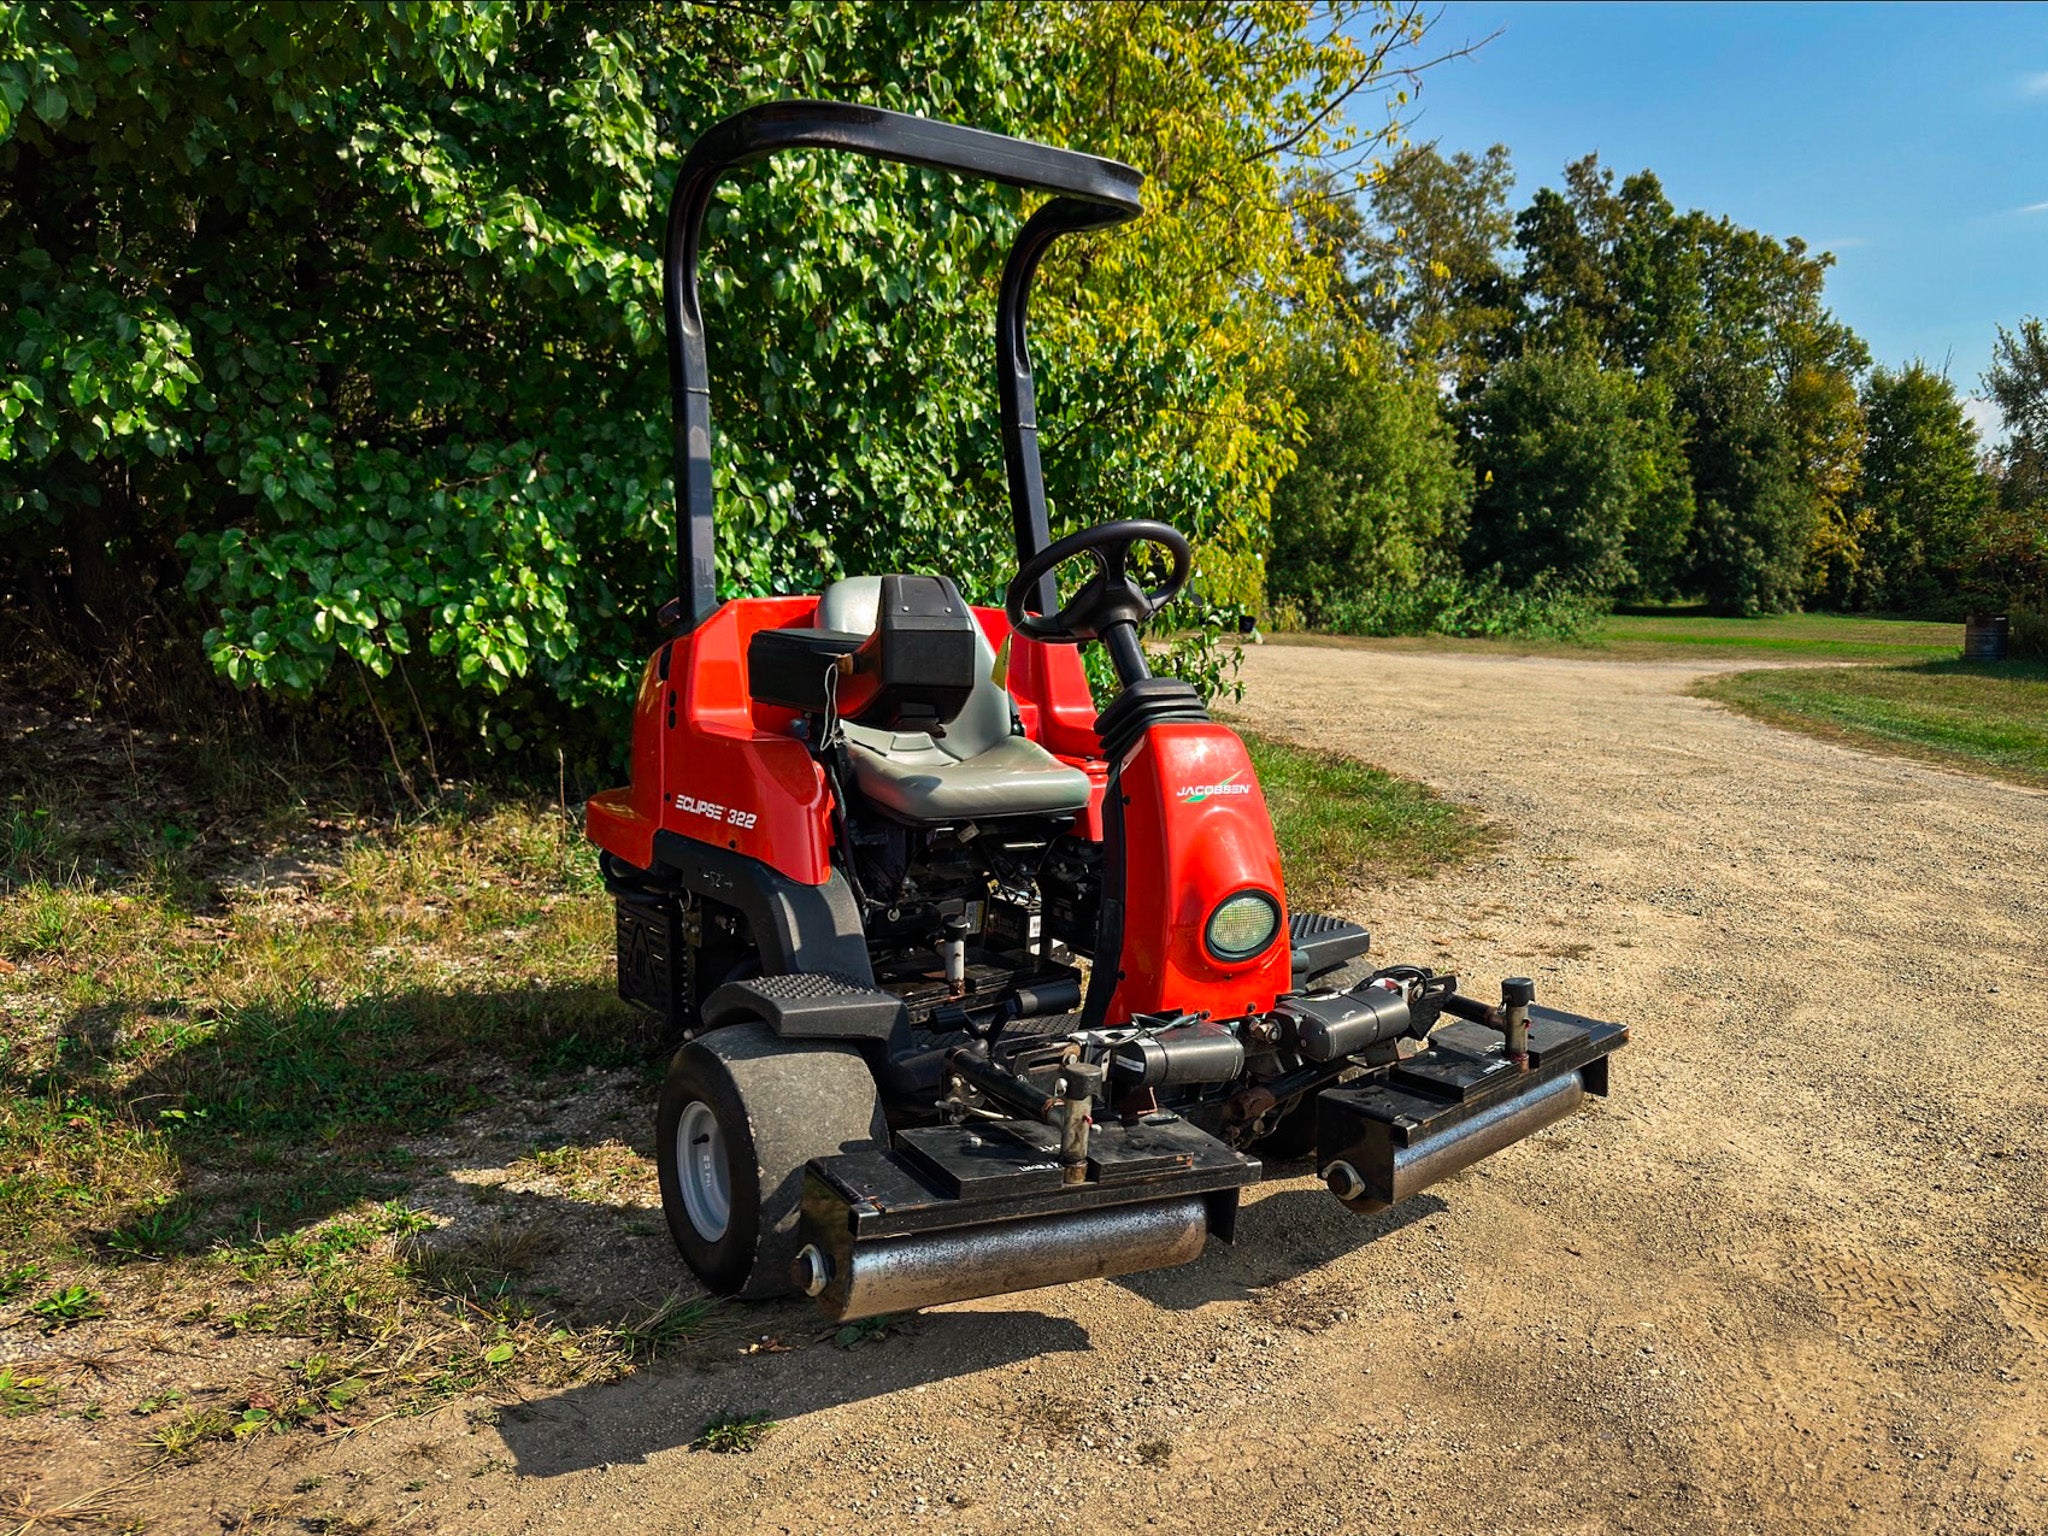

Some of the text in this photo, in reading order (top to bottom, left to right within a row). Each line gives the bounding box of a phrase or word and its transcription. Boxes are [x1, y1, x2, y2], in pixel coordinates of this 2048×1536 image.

[1176, 784, 1250, 797] JACOBSEN
[675, 794, 757, 830] ECLIPSE 322
